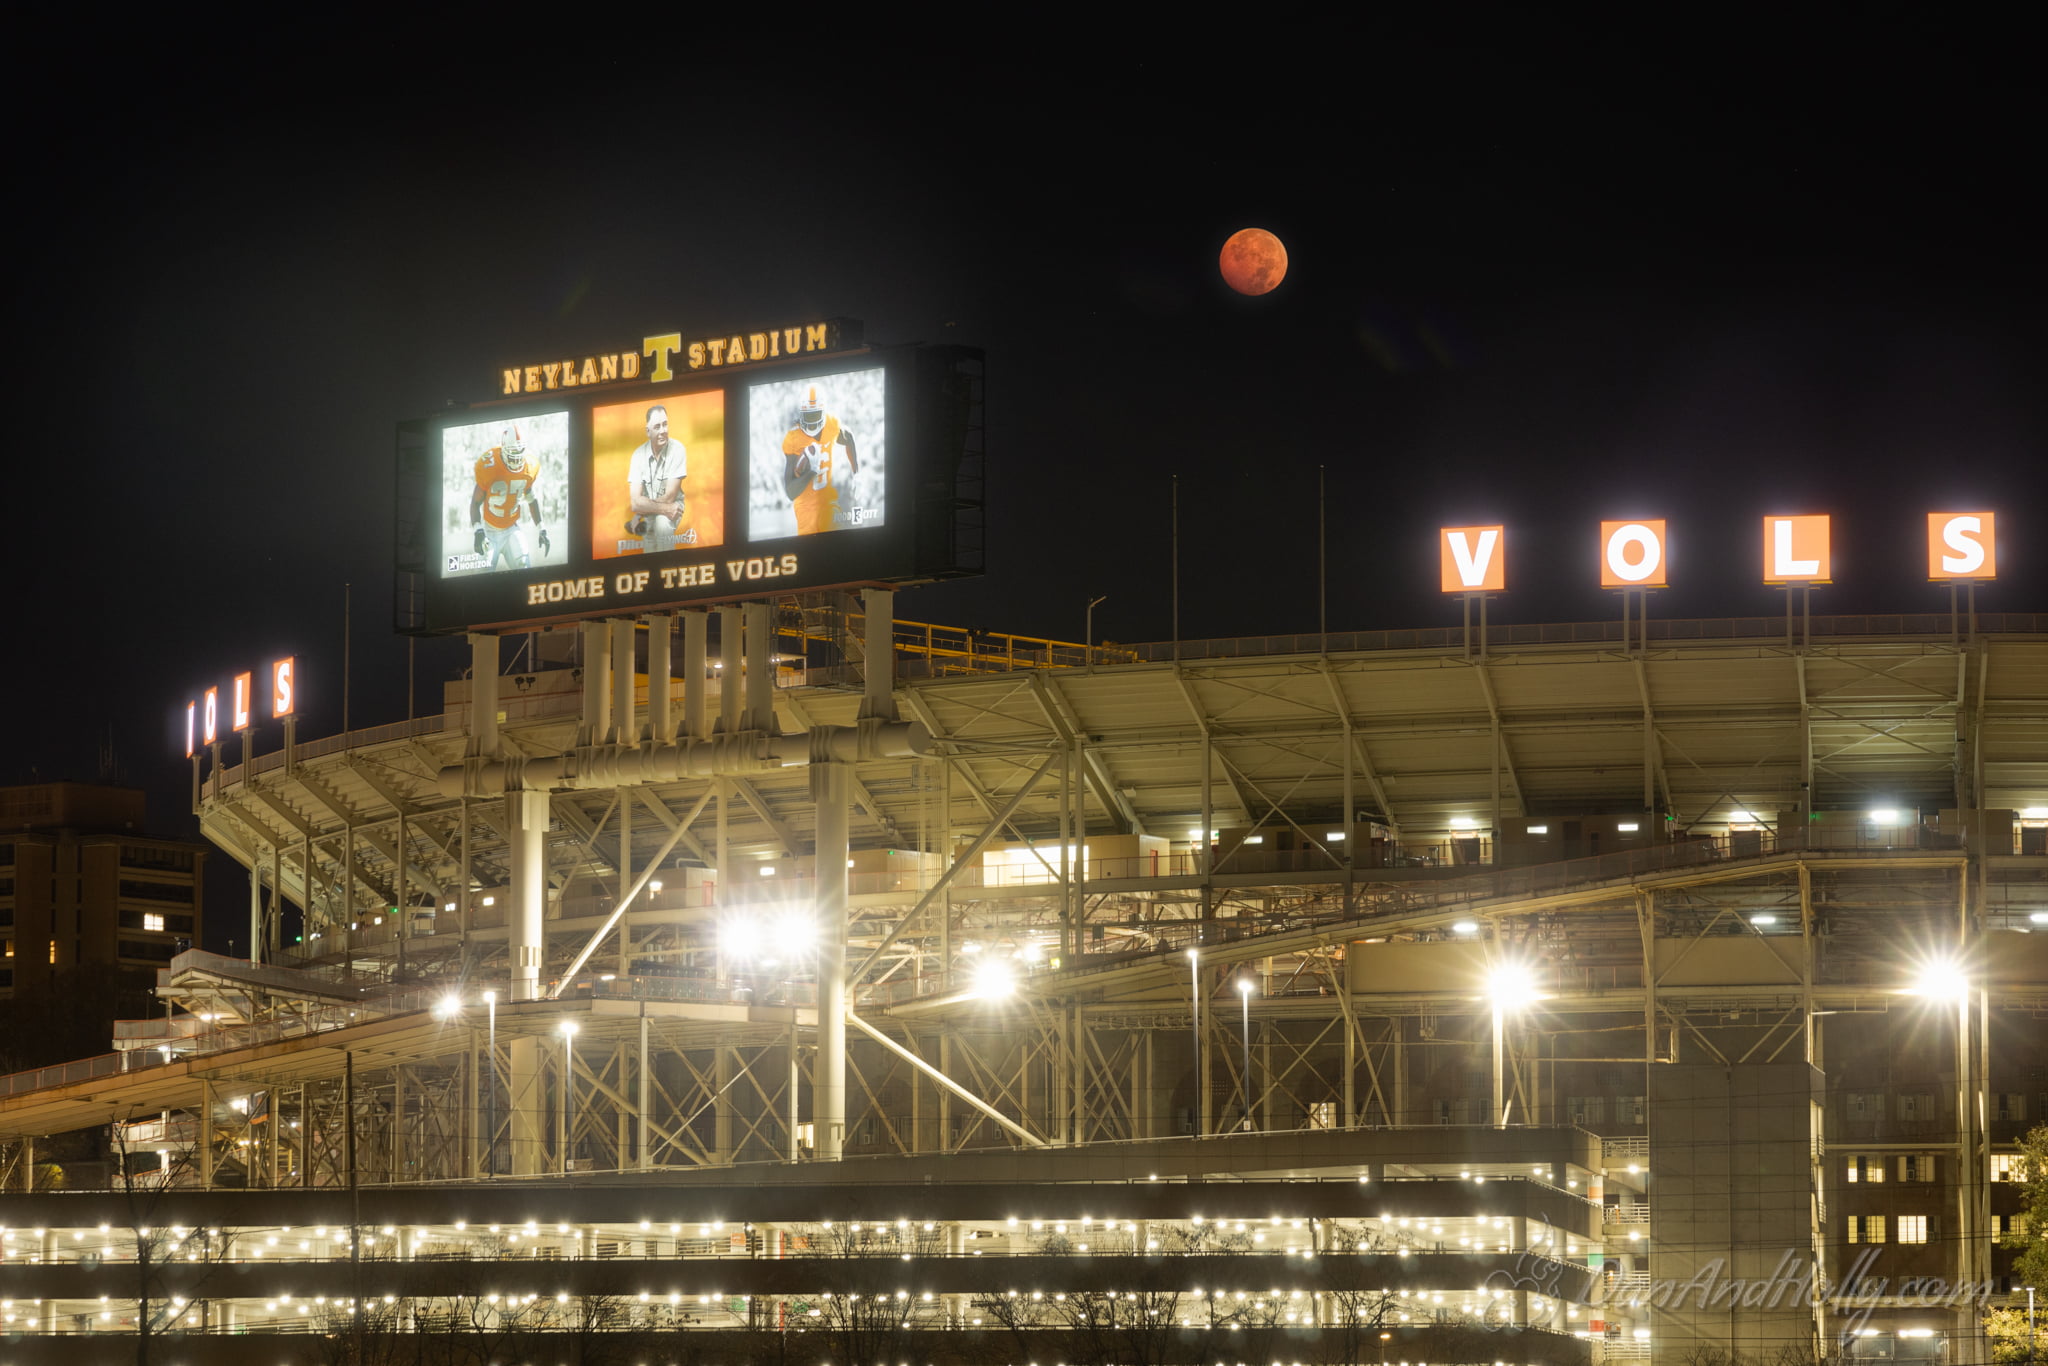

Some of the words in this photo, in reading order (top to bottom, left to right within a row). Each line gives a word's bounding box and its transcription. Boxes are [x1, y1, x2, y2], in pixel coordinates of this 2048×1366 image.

[503, 351, 640, 395] NEYLAND
[643, 332, 681, 383] T
[688, 322, 827, 369] STADIUM
[487, 479, 528, 518] 27
[527, 575, 605, 606] HOME
[615, 570, 650, 595] OF
[660, 563, 716, 589] THE
[726, 553, 798, 582] VOLS
[1446, 515, 1985, 588] VOLS
